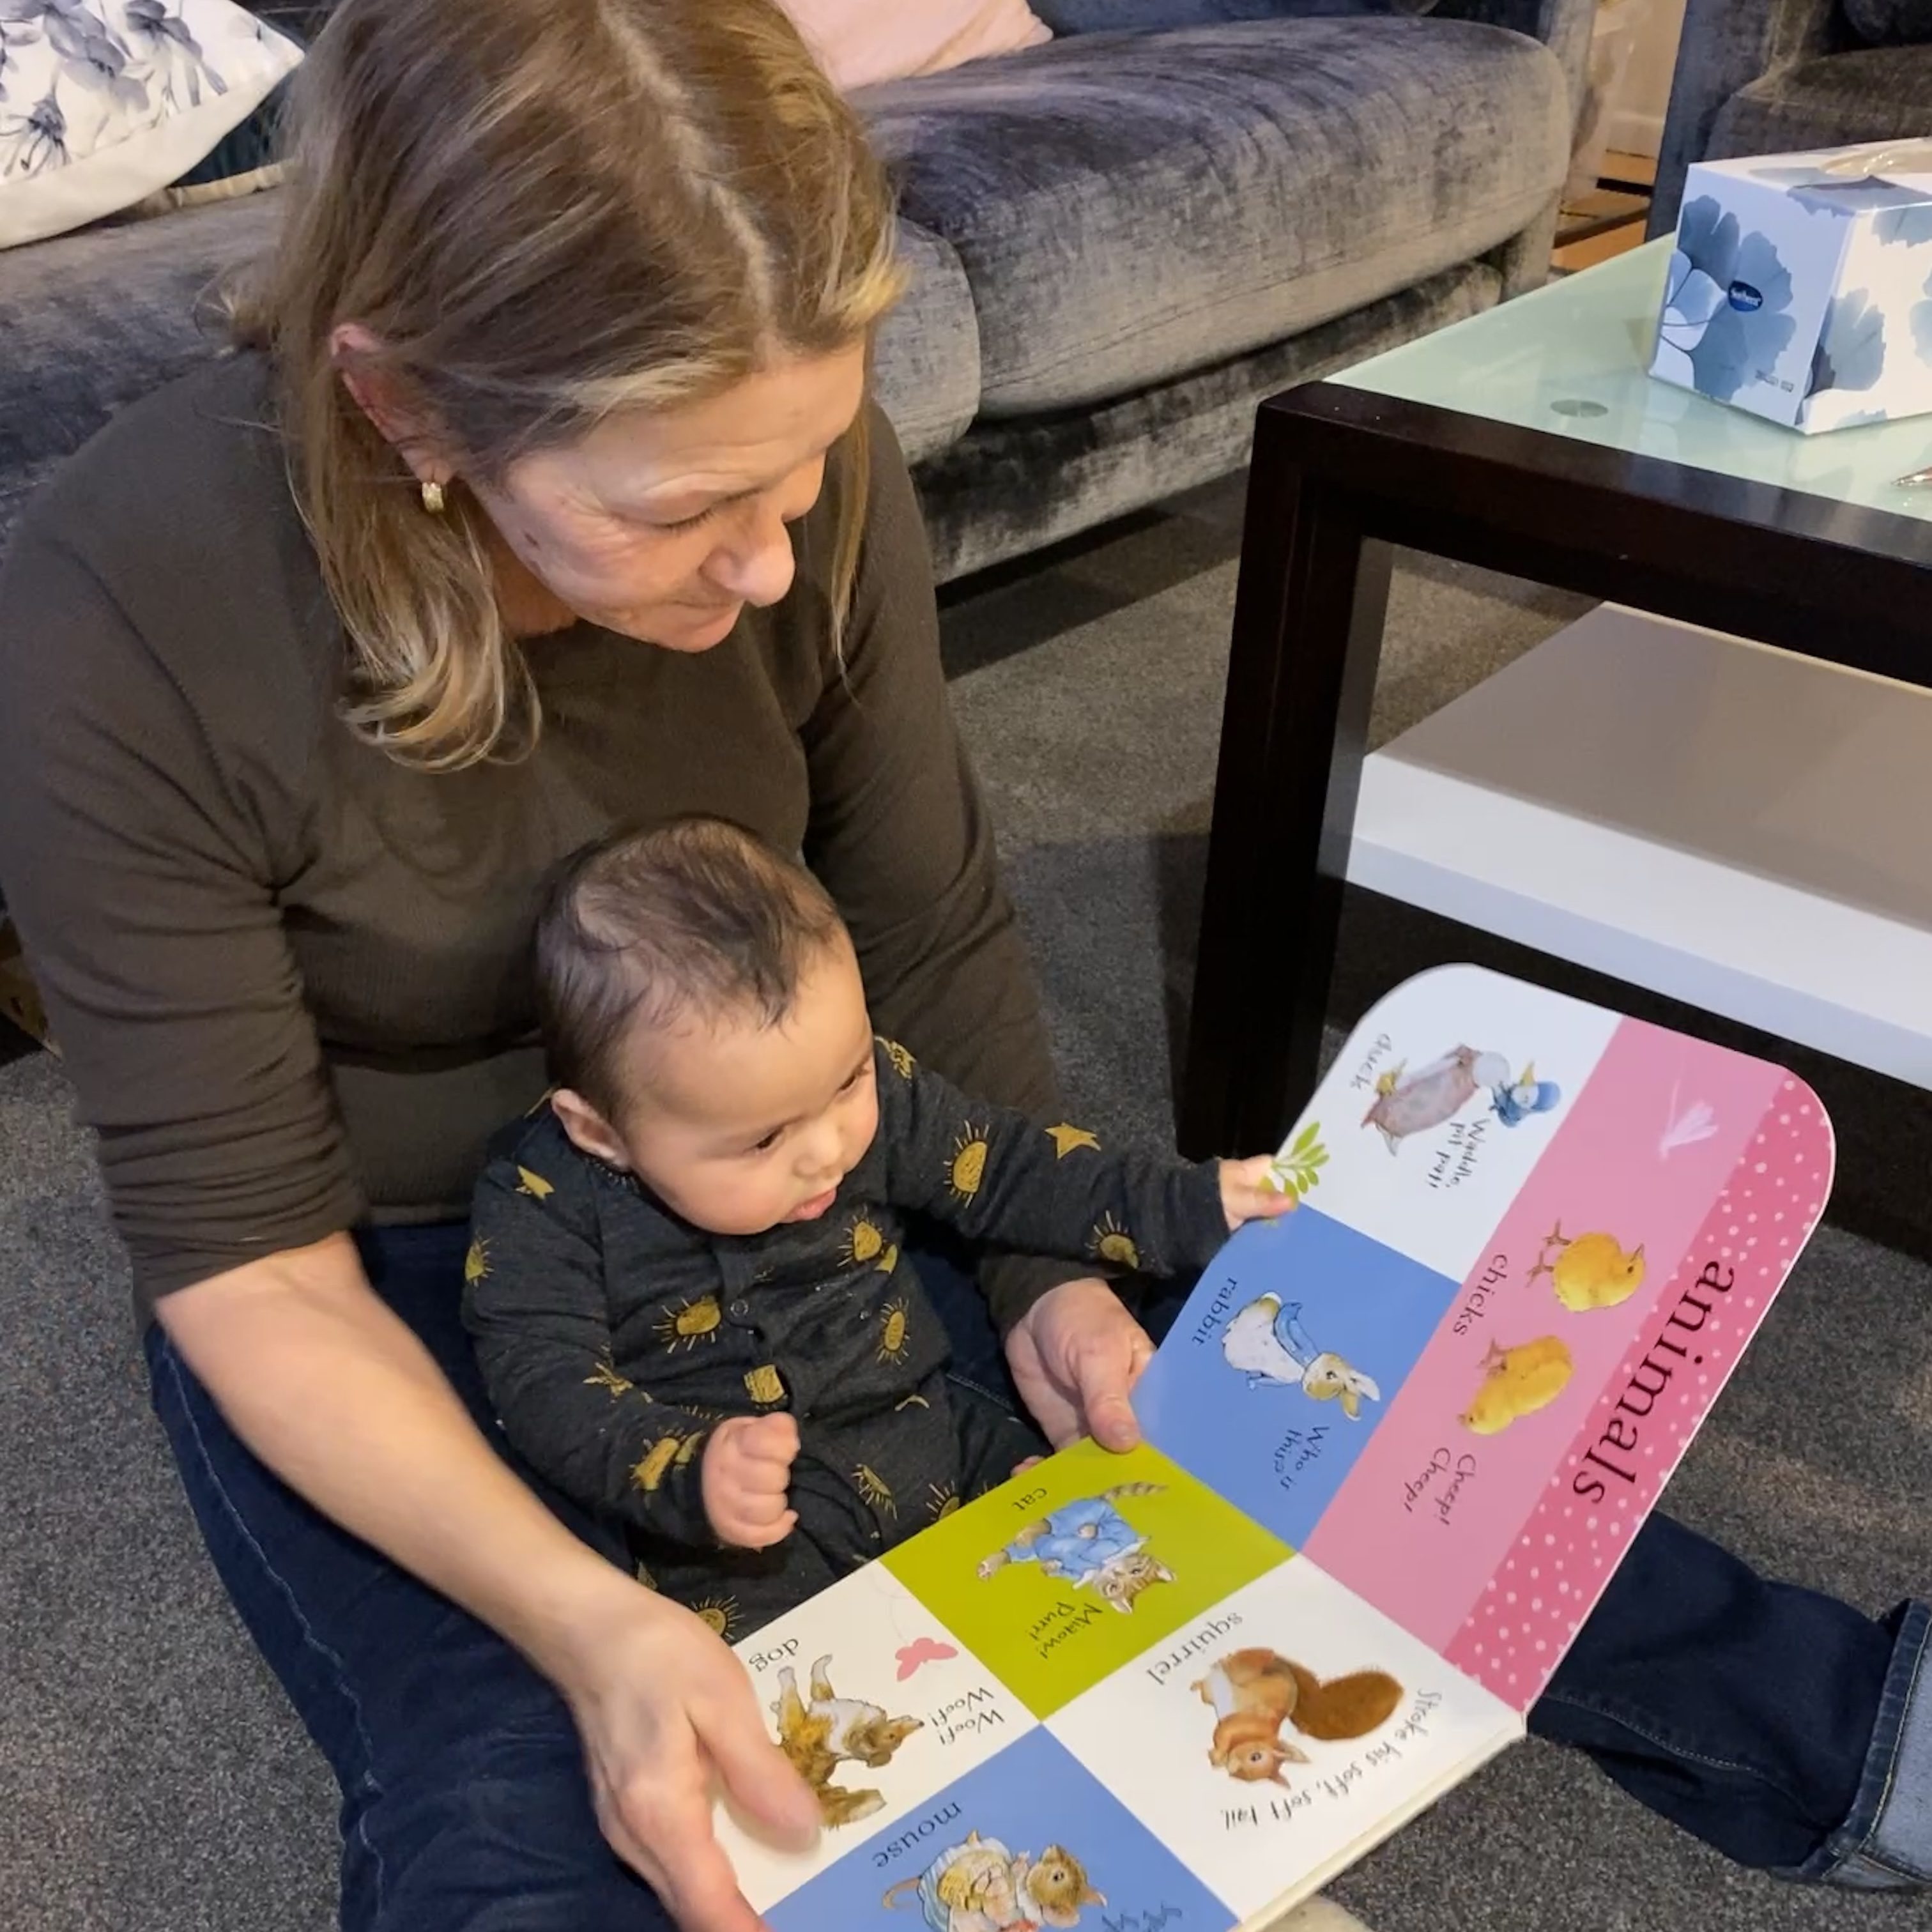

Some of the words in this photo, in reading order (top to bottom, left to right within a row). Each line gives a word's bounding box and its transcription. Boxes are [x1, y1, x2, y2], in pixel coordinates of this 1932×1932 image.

[1350, 1033, 1392, 1090] duck
[1445, 1117, 1491, 1188] Waddle,
[1448, 1123, 1465, 1145] pit
[1192, 1276, 1238, 1346] rabbit
[1453, 1253, 1508, 1336] chicks
[1573, 1261, 1735, 1504] animals
[1296, 1426, 1330, 1470] Who
[1012, 1487, 1048, 1511] cat
[1280, 1475, 1297, 1491] is
[1404, 1447, 1452, 1512] Cheep!
[1435, 1453, 1476, 1526] Cheep!
[1026, 1601, 1076, 1640] Purr!
[1036, 1602, 1103, 1659] Miaow!
[748, 1637, 799, 1673] dog
[1147, 1611, 1243, 1685] squirrel
[928, 1687, 994, 1727] Woof!
[937, 1708, 1004, 1745] Woof!
[1395, 1689, 1442, 1741] Stroke
[1365, 1740, 1402, 1767] his
[1316, 1762, 1363, 1799] soft,
[1220, 1805, 1257, 1830] tail.
[1271, 1790, 1312, 1820] soft
[870, 1800, 963, 1868] mouse
